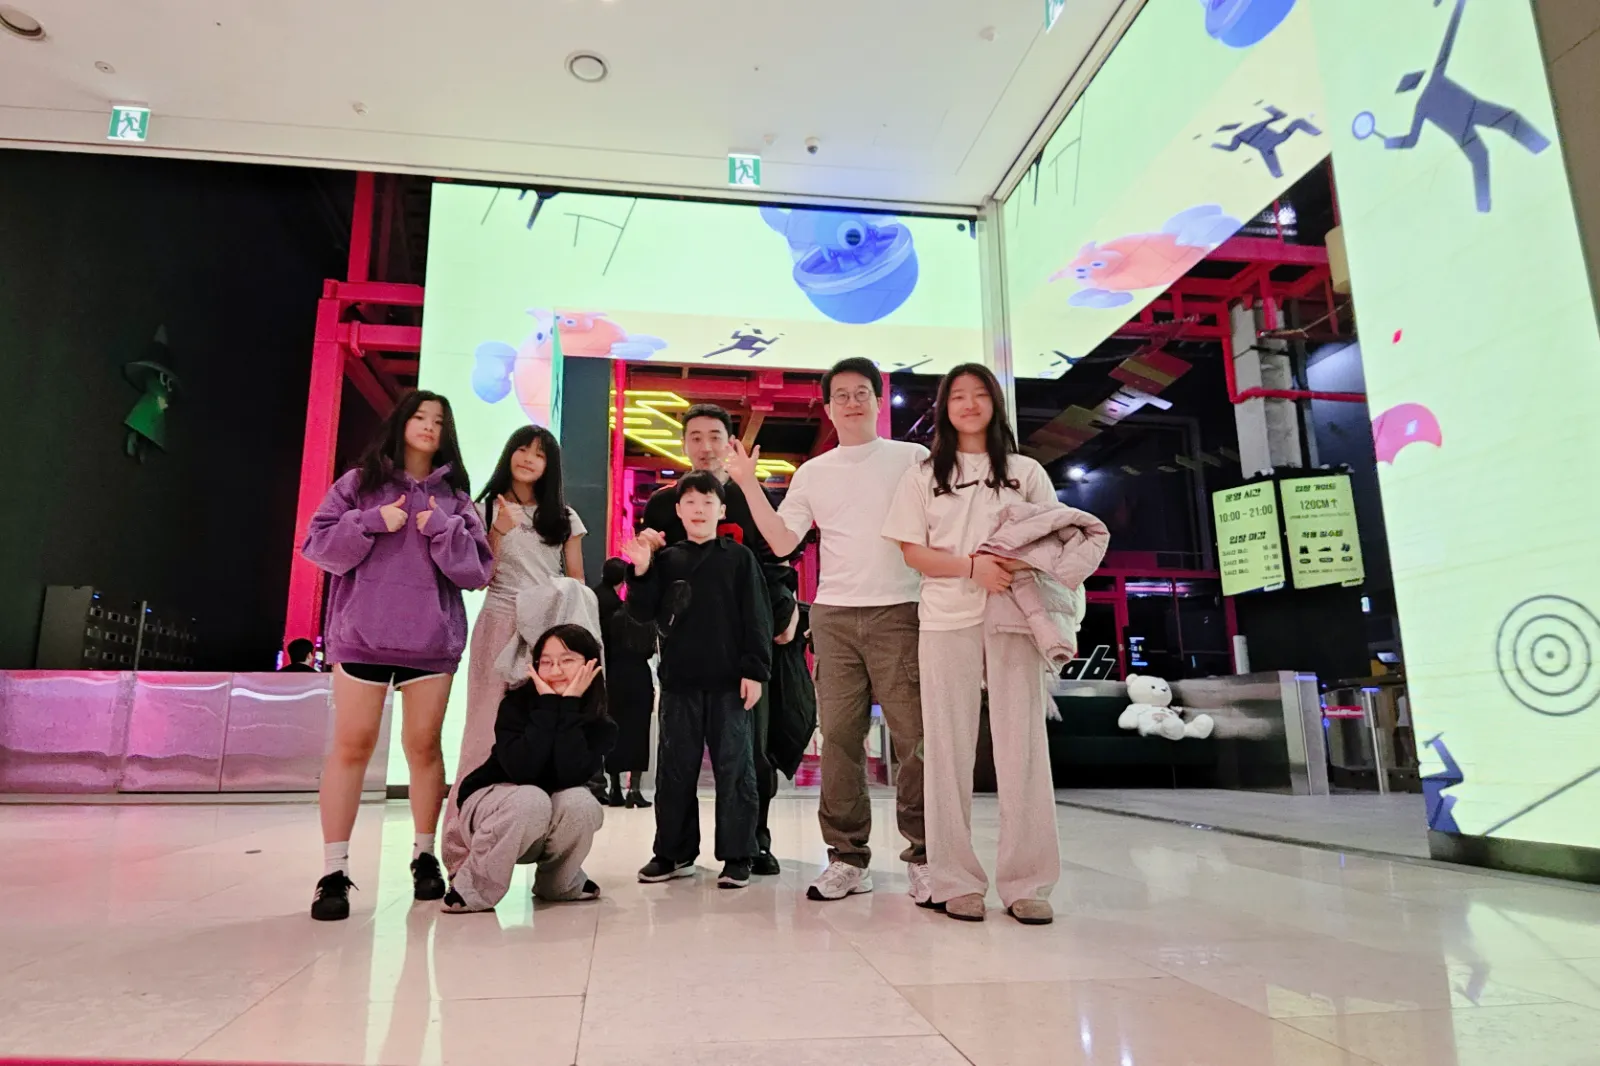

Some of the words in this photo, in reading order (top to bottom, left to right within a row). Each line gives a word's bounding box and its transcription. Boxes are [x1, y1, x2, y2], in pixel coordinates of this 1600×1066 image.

[1244, 487, 1261, 499] 시간
[1299, 498, 1330, 511] 120CM
[1218, 510, 1241, 523] 10:00
[1249, 504, 1273, 518] 21:00
[1229, 533, 1247, 544] 입장
[1248, 530, 1266, 541] 마감
